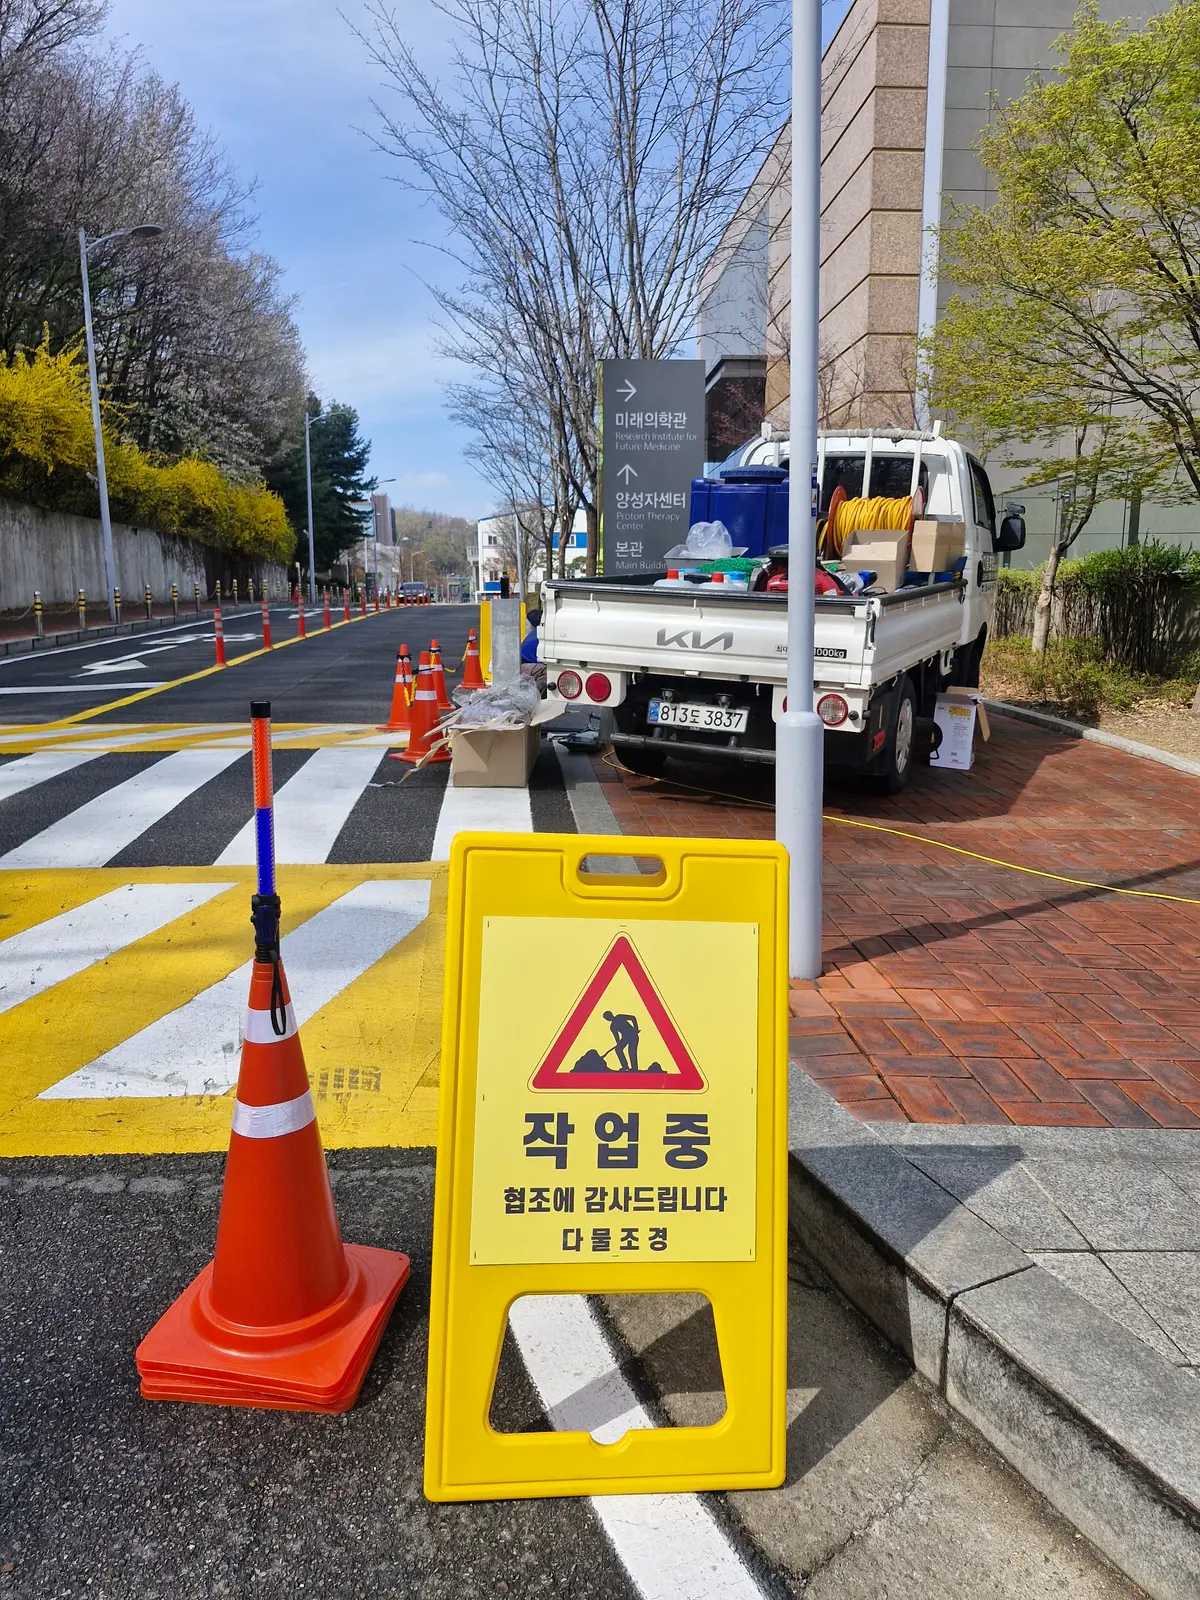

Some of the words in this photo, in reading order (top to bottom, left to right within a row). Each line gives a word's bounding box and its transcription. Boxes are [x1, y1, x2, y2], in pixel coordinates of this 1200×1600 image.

[615, 411, 687, 429] 미래의학관
[615, 432, 650, 441] Research
[652, 432, 684, 441] Institute
[686, 432, 697, 441] for
[615, 442, 642, 451] Future
[644, 442, 680, 451] Medicine
[615, 492, 686, 509] 양성자센터
[616, 512, 645, 521] Proton
[647, 512, 680, 522] Therapy
[616, 522, 644, 530] Center
[615, 541, 643, 558] 본관
[615, 561, 638, 570] Main
[813, 648, 845, 659] 1000kg
[660, 705, 700, 724] 813도
[704, 709, 744, 729] 3837
[503, 1186, 575, 1214] 협조에
[584, 1186, 728, 1212] 감사드립니다
